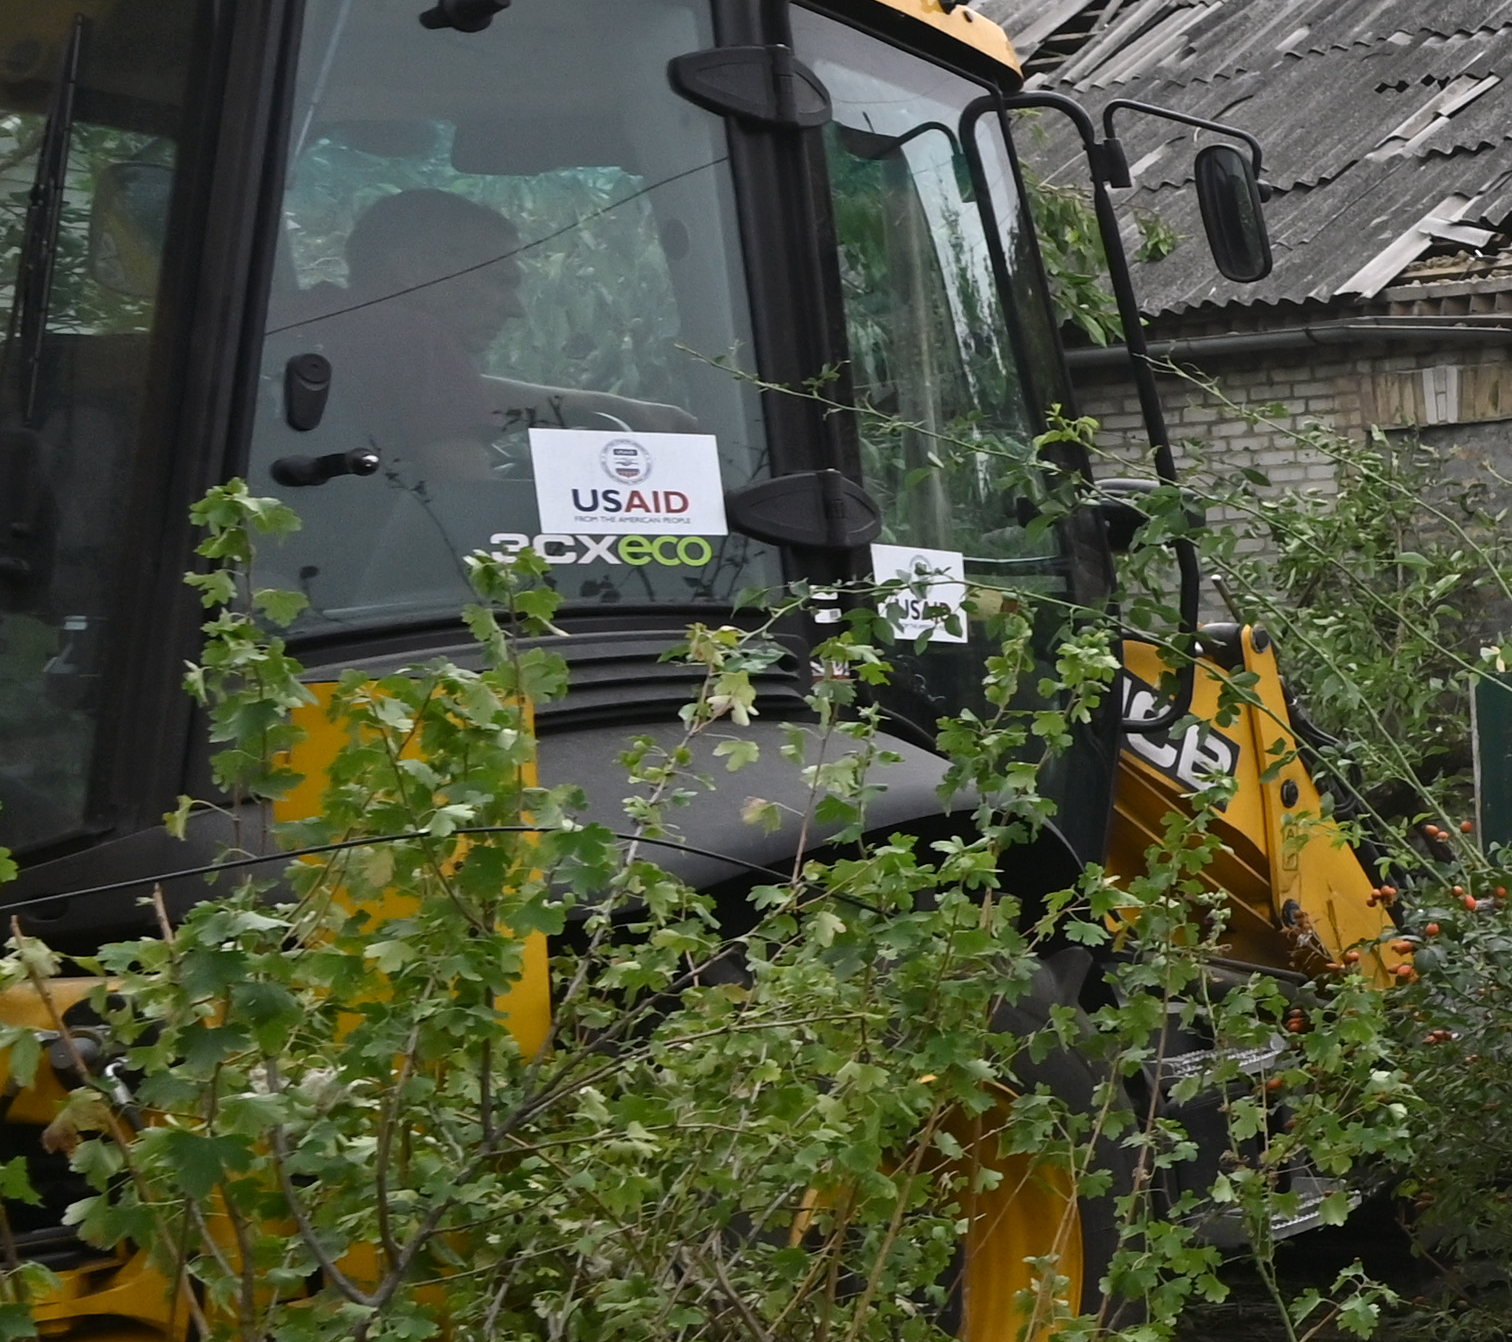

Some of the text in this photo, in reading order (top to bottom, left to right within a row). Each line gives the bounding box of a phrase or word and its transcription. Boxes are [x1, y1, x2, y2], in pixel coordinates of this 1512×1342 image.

[571, 489, 690, 514] USAID
[574, 515, 599, 523] FROM
[618, 516, 661, 525] AMERICAN
[662, 517, 692, 525] PEOPLE
[1123, 676, 1233, 795] CB
